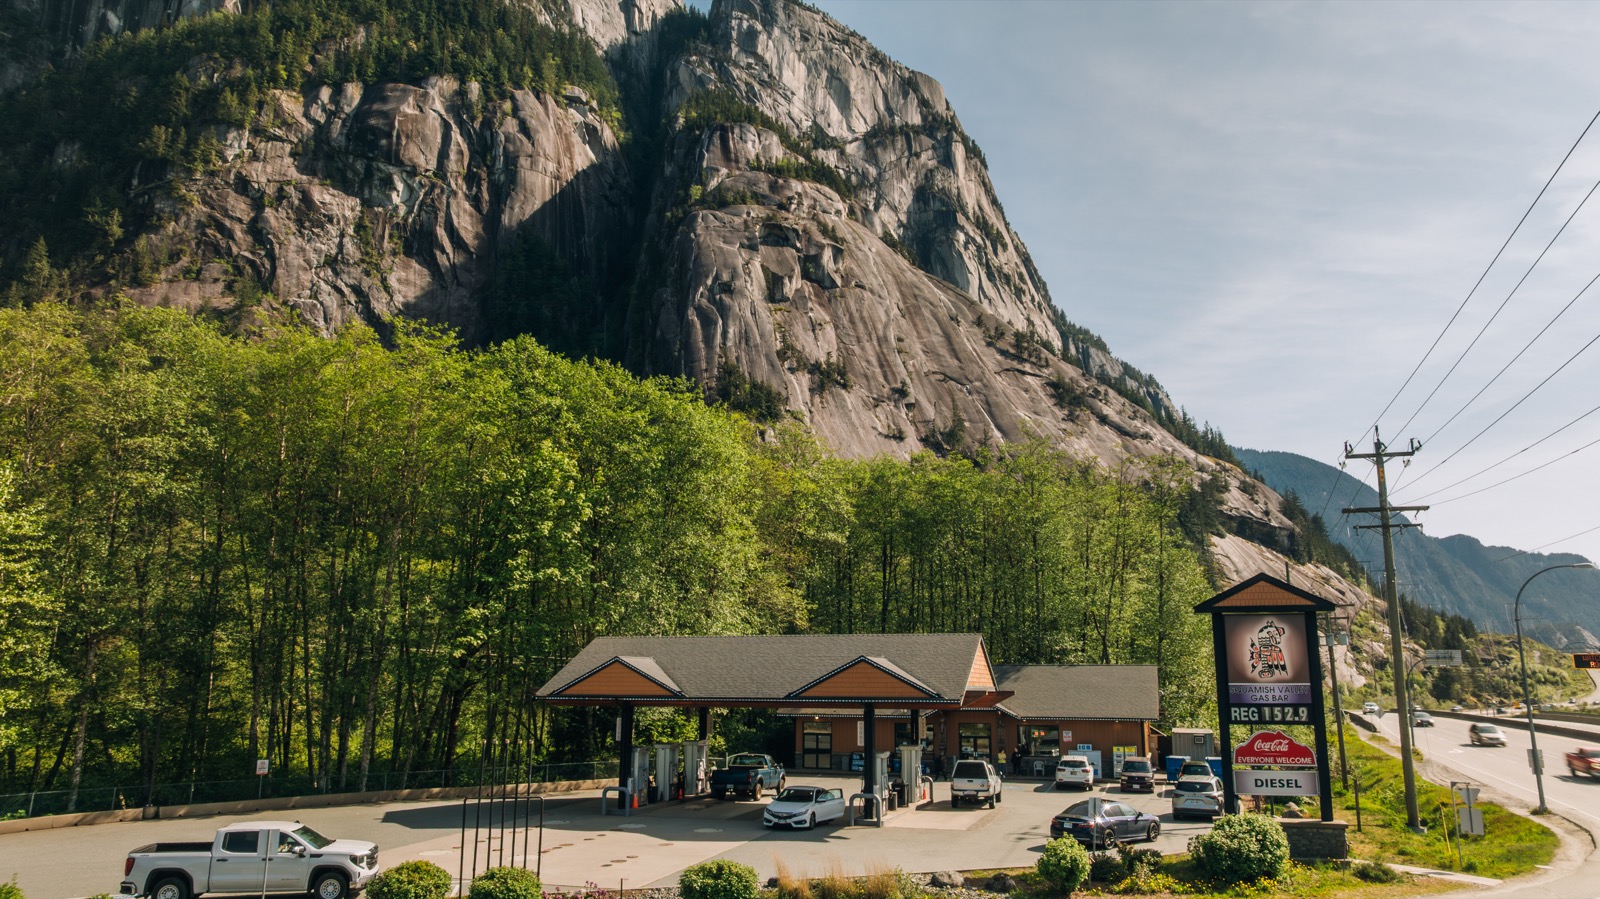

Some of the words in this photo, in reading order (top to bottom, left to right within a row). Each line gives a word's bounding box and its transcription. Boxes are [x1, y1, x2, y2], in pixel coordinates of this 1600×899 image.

[1230, 686, 1275, 694] SQUAMISH
[1278, 686, 1308, 694] VALLEY
[1231, 707, 1259, 721] REG
[1263, 707, 1308, 721] 152.9
[1238, 756, 1275, 764] EVERYONE
[1254, 778, 1303, 788] DIESEL
